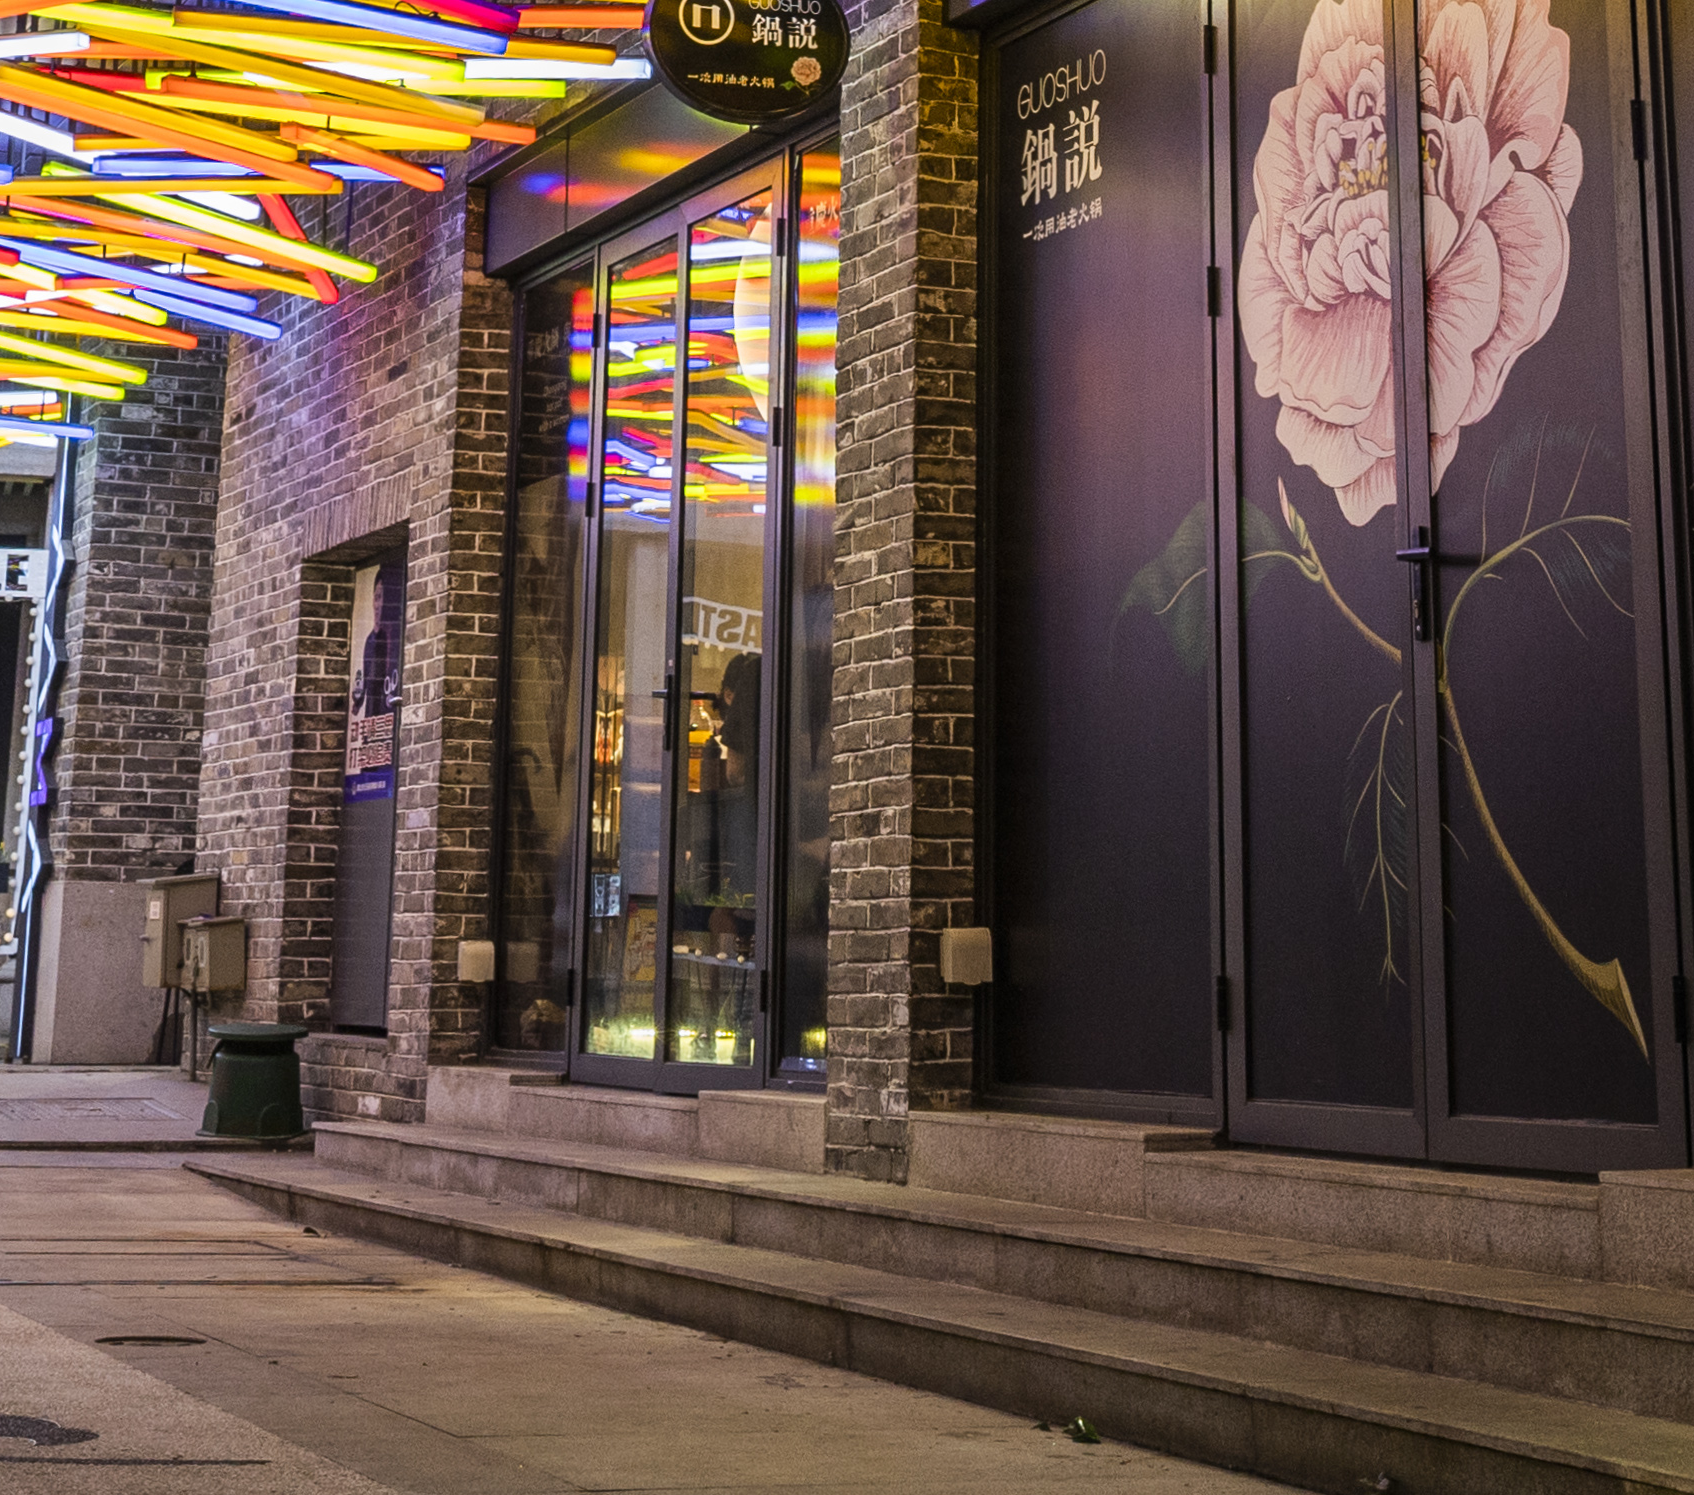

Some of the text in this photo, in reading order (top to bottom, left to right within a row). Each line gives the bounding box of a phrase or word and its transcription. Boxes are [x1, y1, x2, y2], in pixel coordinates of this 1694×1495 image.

[1017, 49, 1106, 120] GUOSHUO
[1022, 196, 1103, 242] 一次用油老火锅
